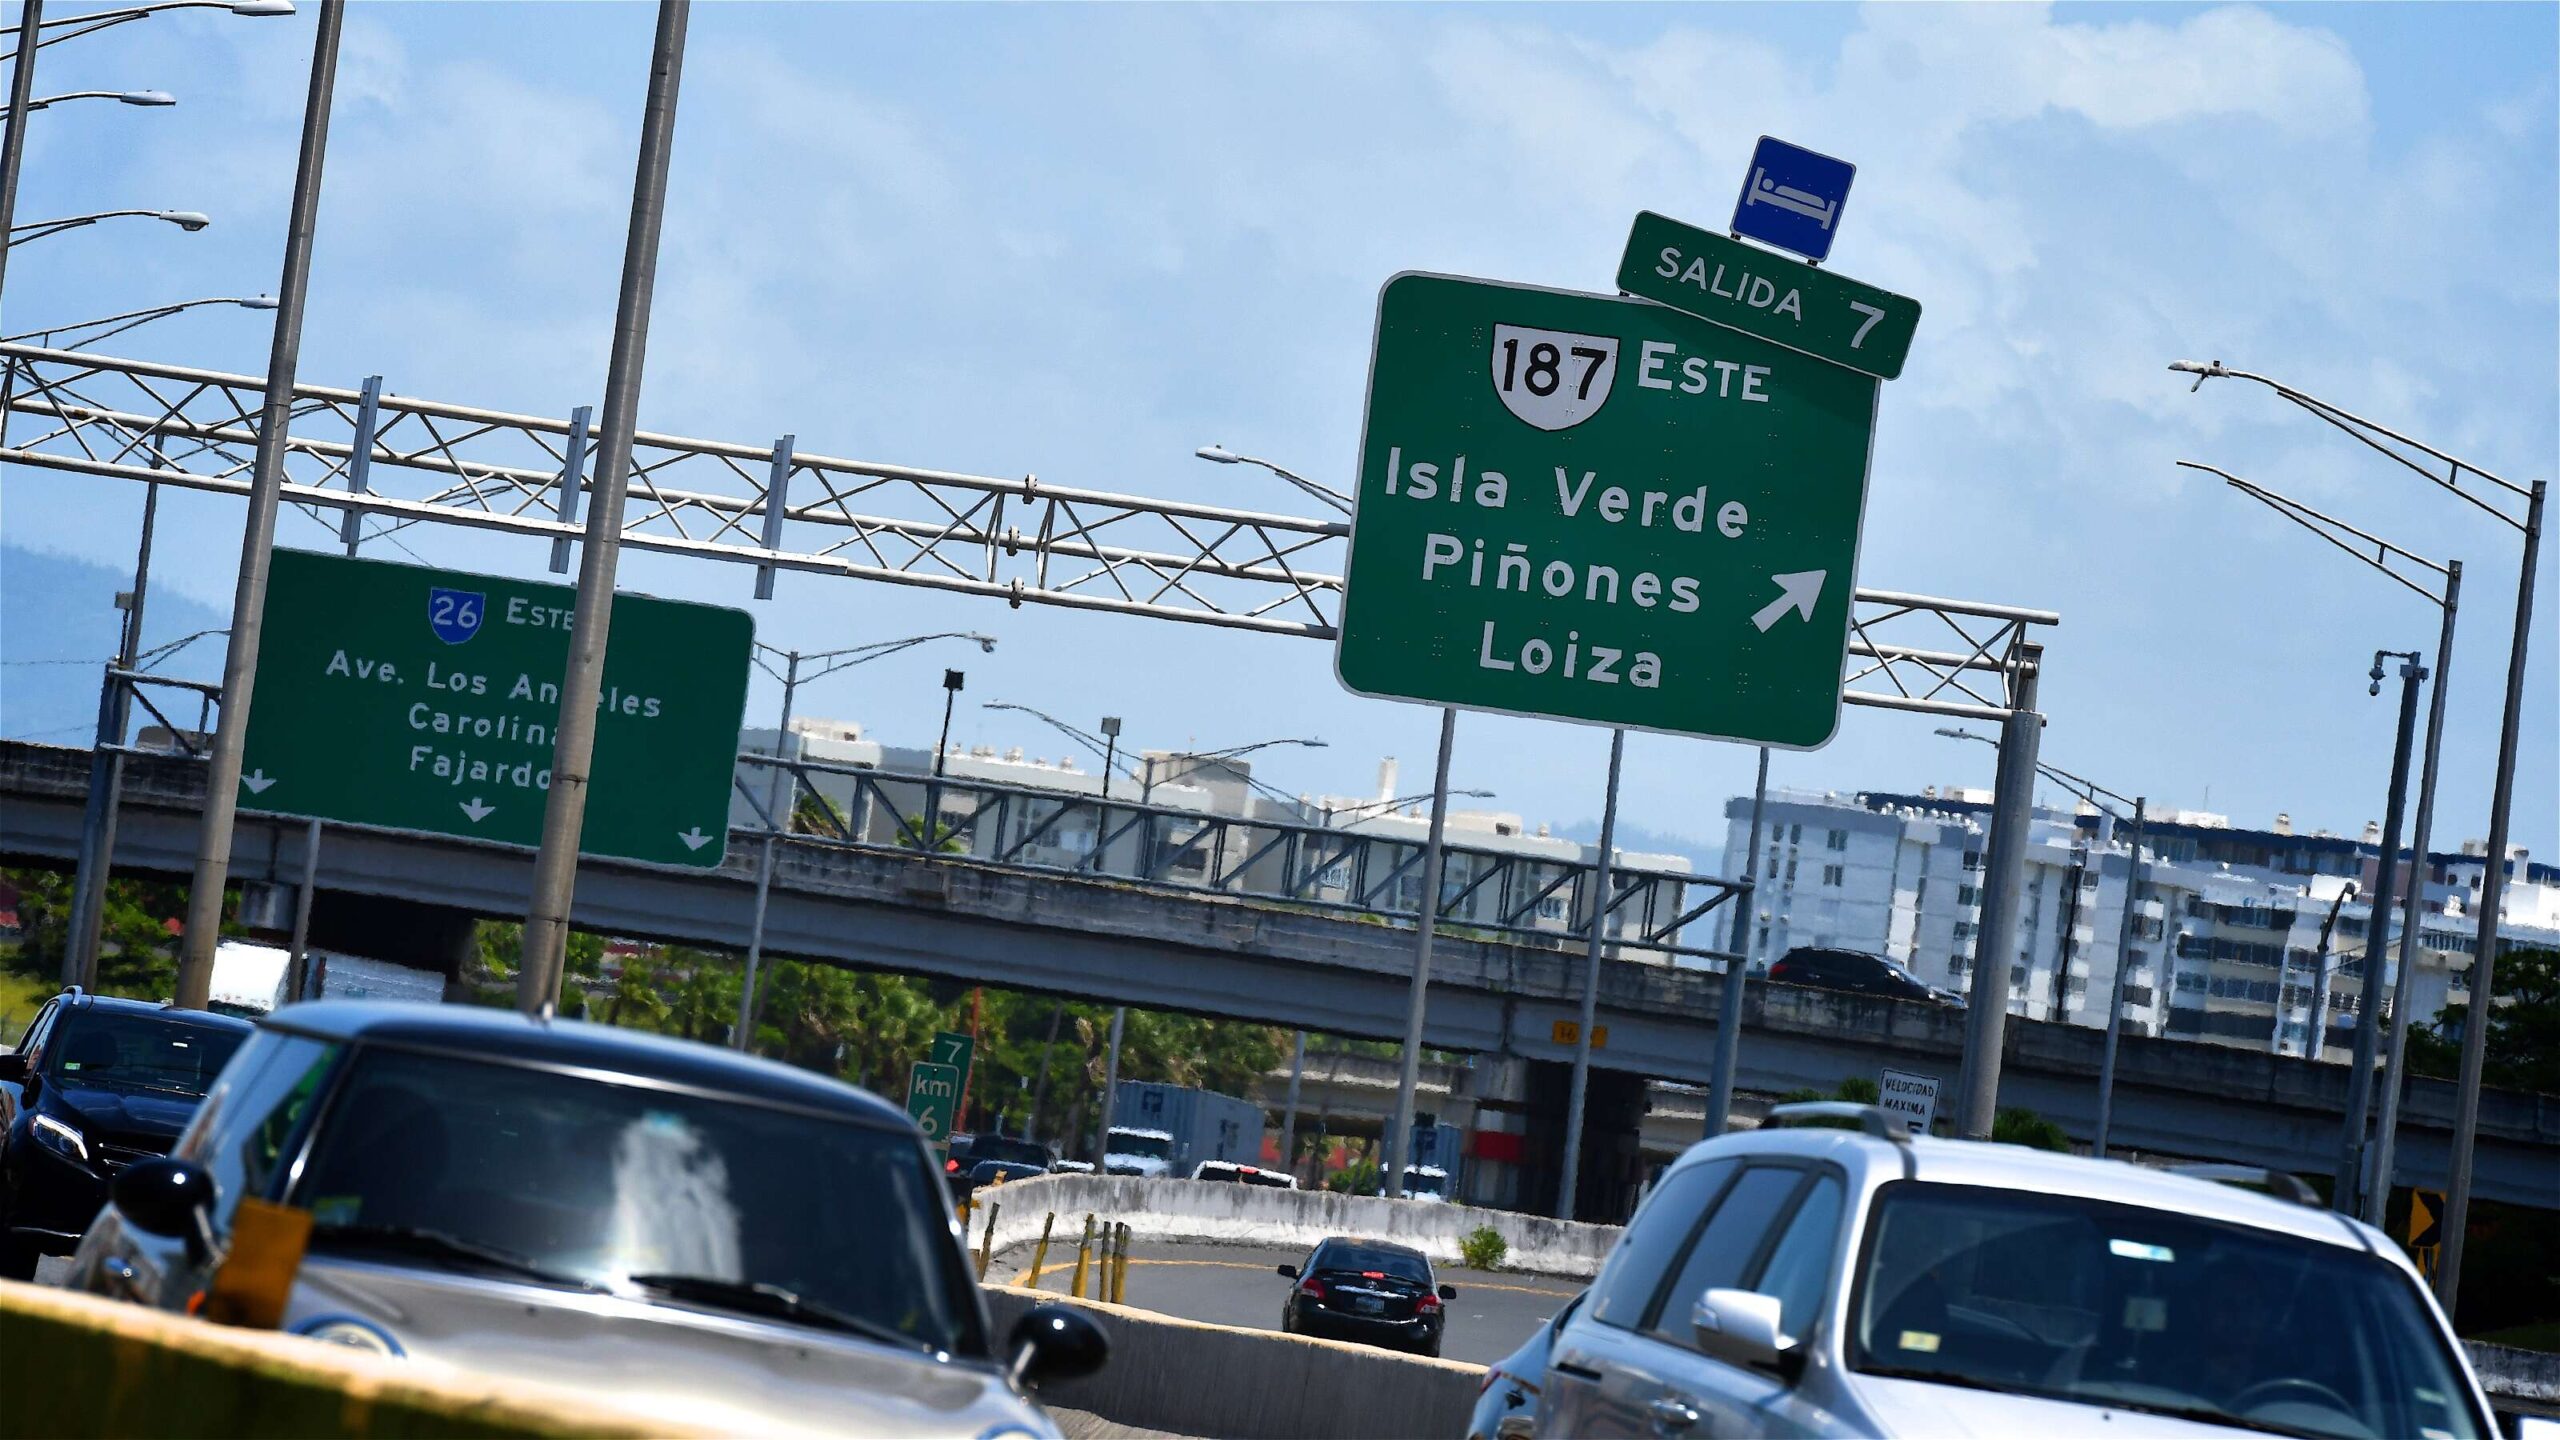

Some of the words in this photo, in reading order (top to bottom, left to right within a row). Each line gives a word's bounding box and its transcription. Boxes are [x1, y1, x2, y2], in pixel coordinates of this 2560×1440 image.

[1655, 247, 1802, 322] SALIDA
[1850, 301, 1886, 349] 7
[1501, 338, 1608, 400] 187
[1638, 340, 1771, 402] ESTE
[1385, 447, 1508, 508] Isla
[1554, 466, 1749, 538] Verde
[1422, 533, 1701, 613] Piñones
[433, 595, 478, 629] 26
[506, 596, 575, 631] ESTE
[1479, 621, 1663, 689] Loiza
[325, 649, 404, 684] Ave.
[427, 661, 488, 695] Los
[508, 672, 661, 718] Anles
[409, 745, 552, 790] Fajardo
[945, 1040, 963, 1063] 7
[915, 1074, 951, 1098] km
[1883, 1098, 1925, 1115] MAXIMA
[1885, 1078, 1934, 1097] VELOCIDAD
[918, 1105, 938, 1136] 6
